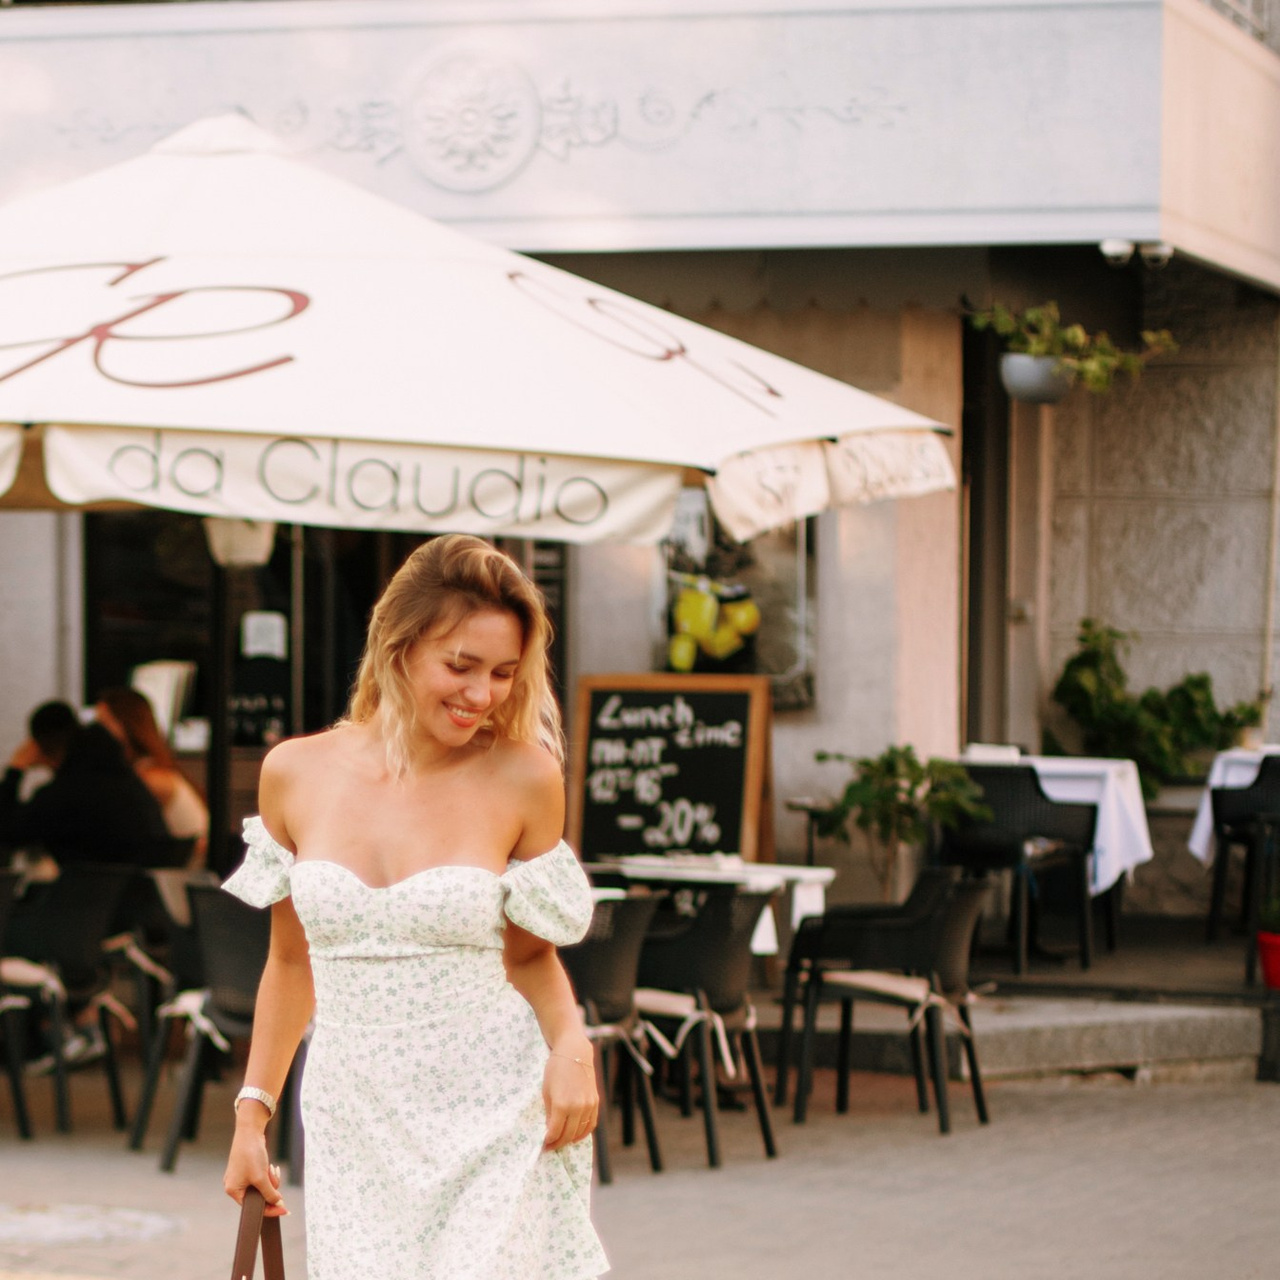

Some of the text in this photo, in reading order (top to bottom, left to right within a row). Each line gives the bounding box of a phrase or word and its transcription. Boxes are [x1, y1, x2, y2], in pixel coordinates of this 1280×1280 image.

[107, 429, 608, 525] da Claudio
[596, 694, 695, 730] Lunch
